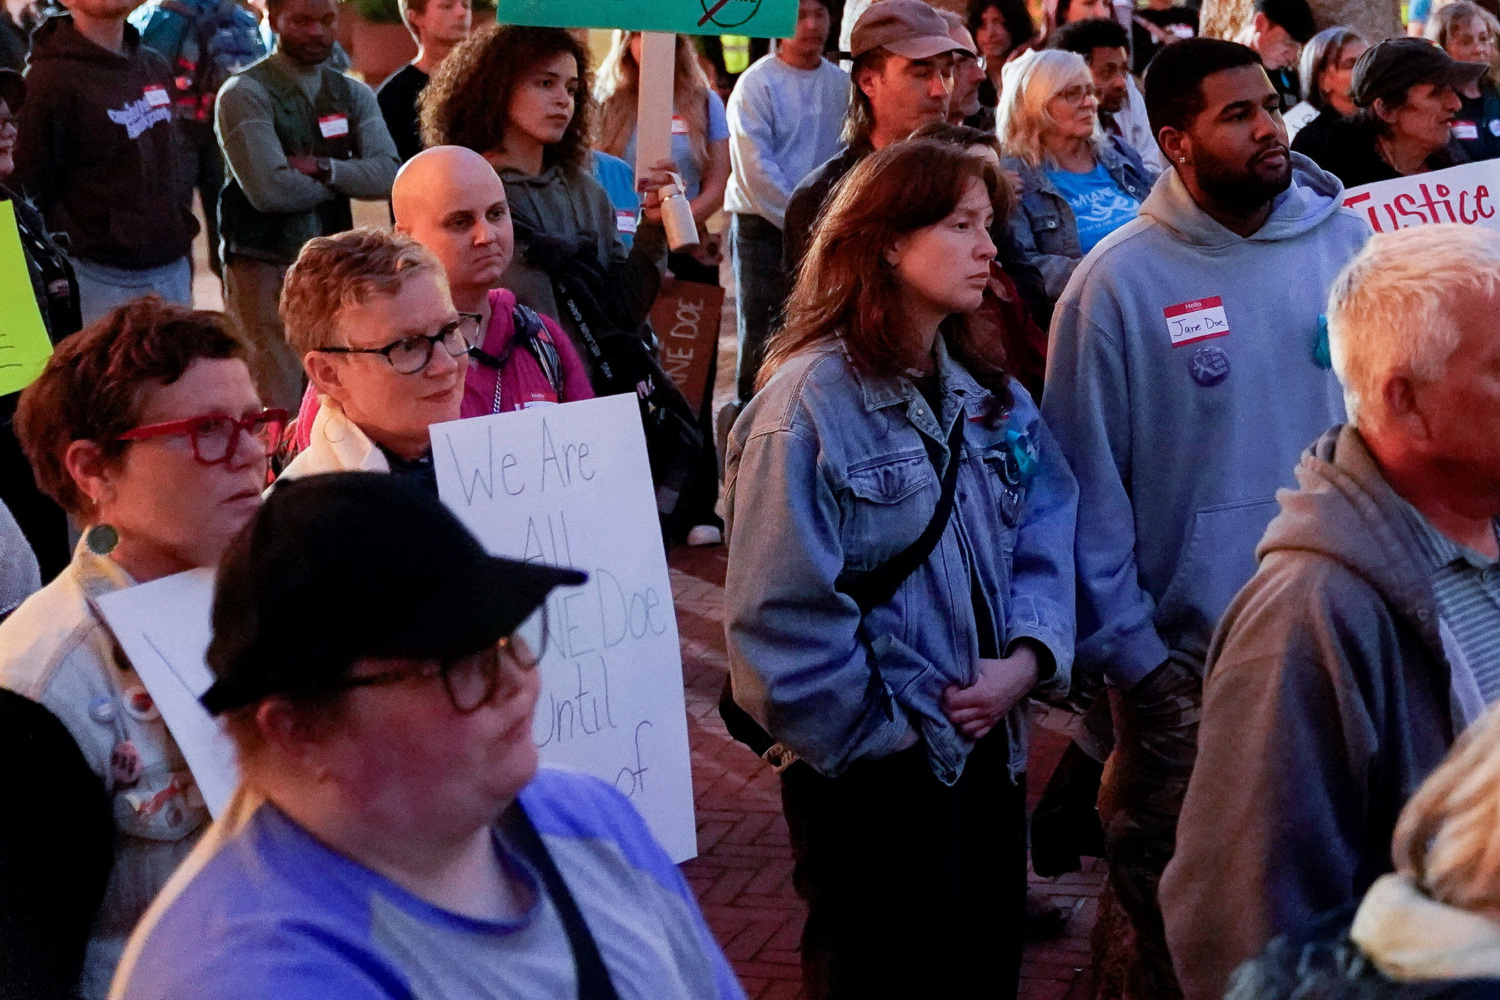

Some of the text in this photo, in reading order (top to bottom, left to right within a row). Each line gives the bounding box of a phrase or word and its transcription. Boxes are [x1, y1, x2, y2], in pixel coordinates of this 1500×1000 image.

[1171, 317, 1226, 337] Jane Doe
[1184, 301, 1202, 310] Hello
[445, 417, 596, 507] We Are
[523, 510, 573, 569] All
[596, 567, 667, 651] Doe
[615, 720, 653, 799] of
